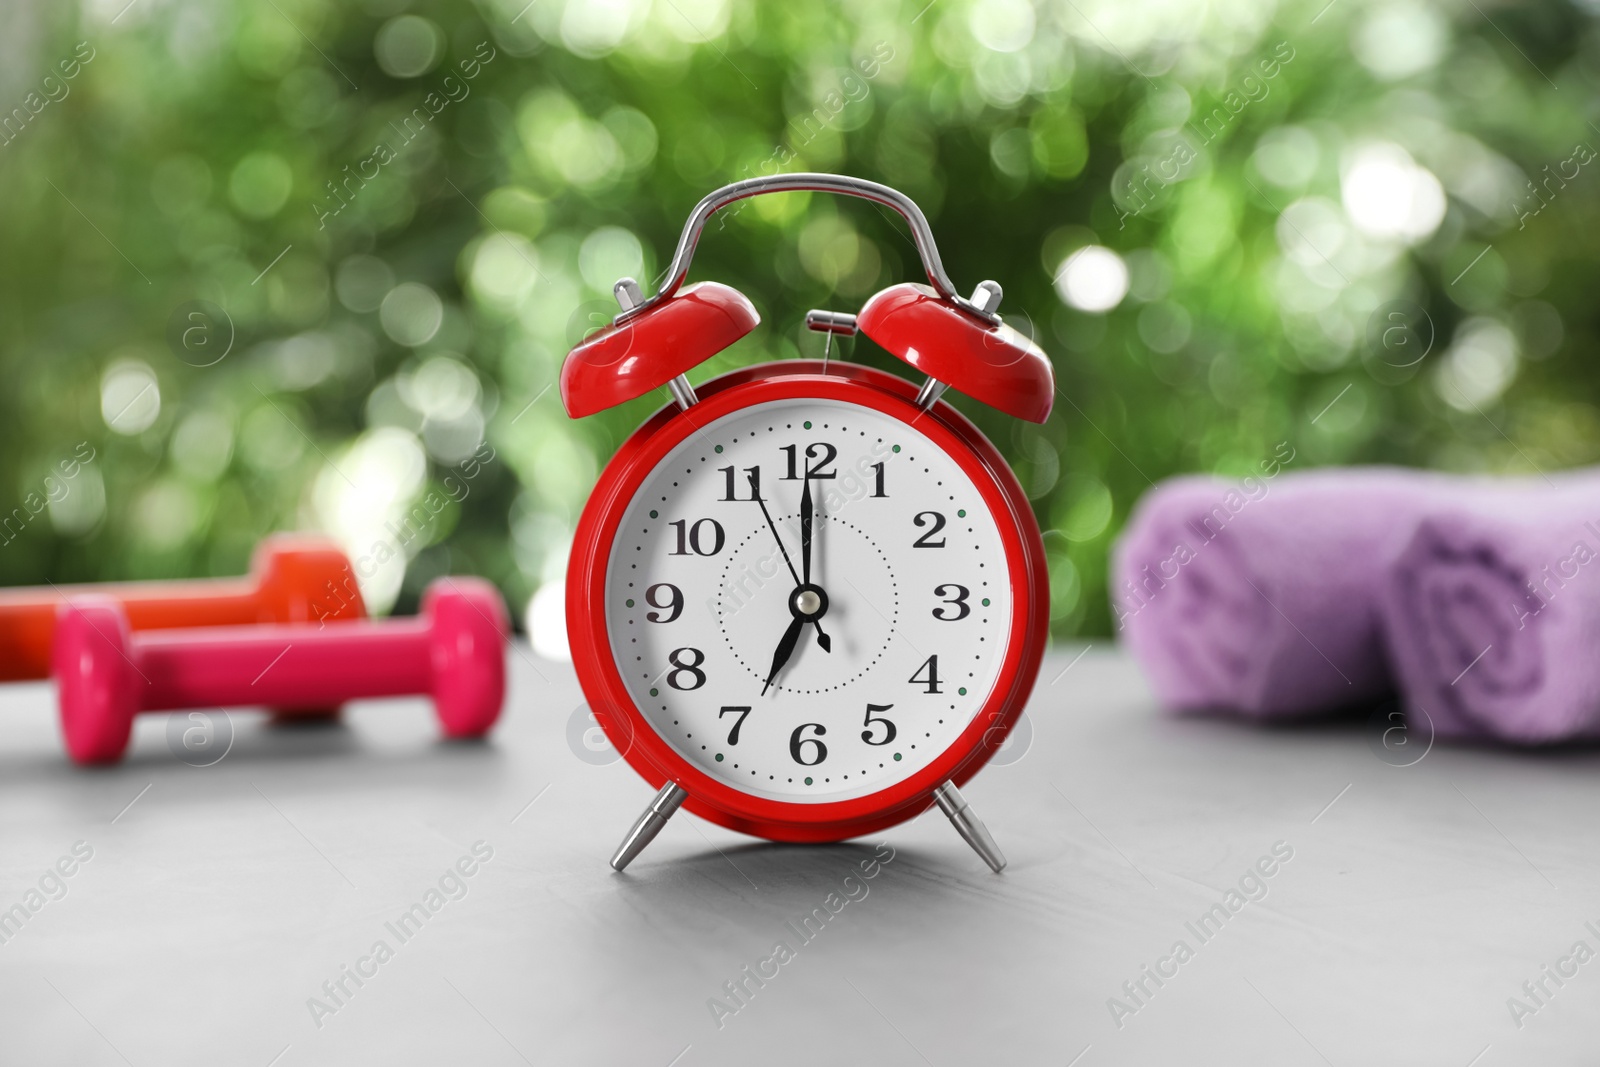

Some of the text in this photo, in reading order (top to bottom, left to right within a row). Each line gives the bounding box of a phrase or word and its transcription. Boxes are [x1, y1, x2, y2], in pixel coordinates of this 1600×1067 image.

[779, 442, 837, 480] 12
[869, 461, 890, 498] 1
[717, 465, 768, 502] 11
[668, 518, 726, 557] 10
[912, 511, 947, 549] 2
[645, 583, 685, 624] 9
[931, 583, 971, 622] 3
[666, 647, 707, 691] 8
[908, 654, 944, 694] 4
[718, 706, 752, 746] 7
[860, 703, 897, 746] 5
[789, 723, 828, 766] 6
